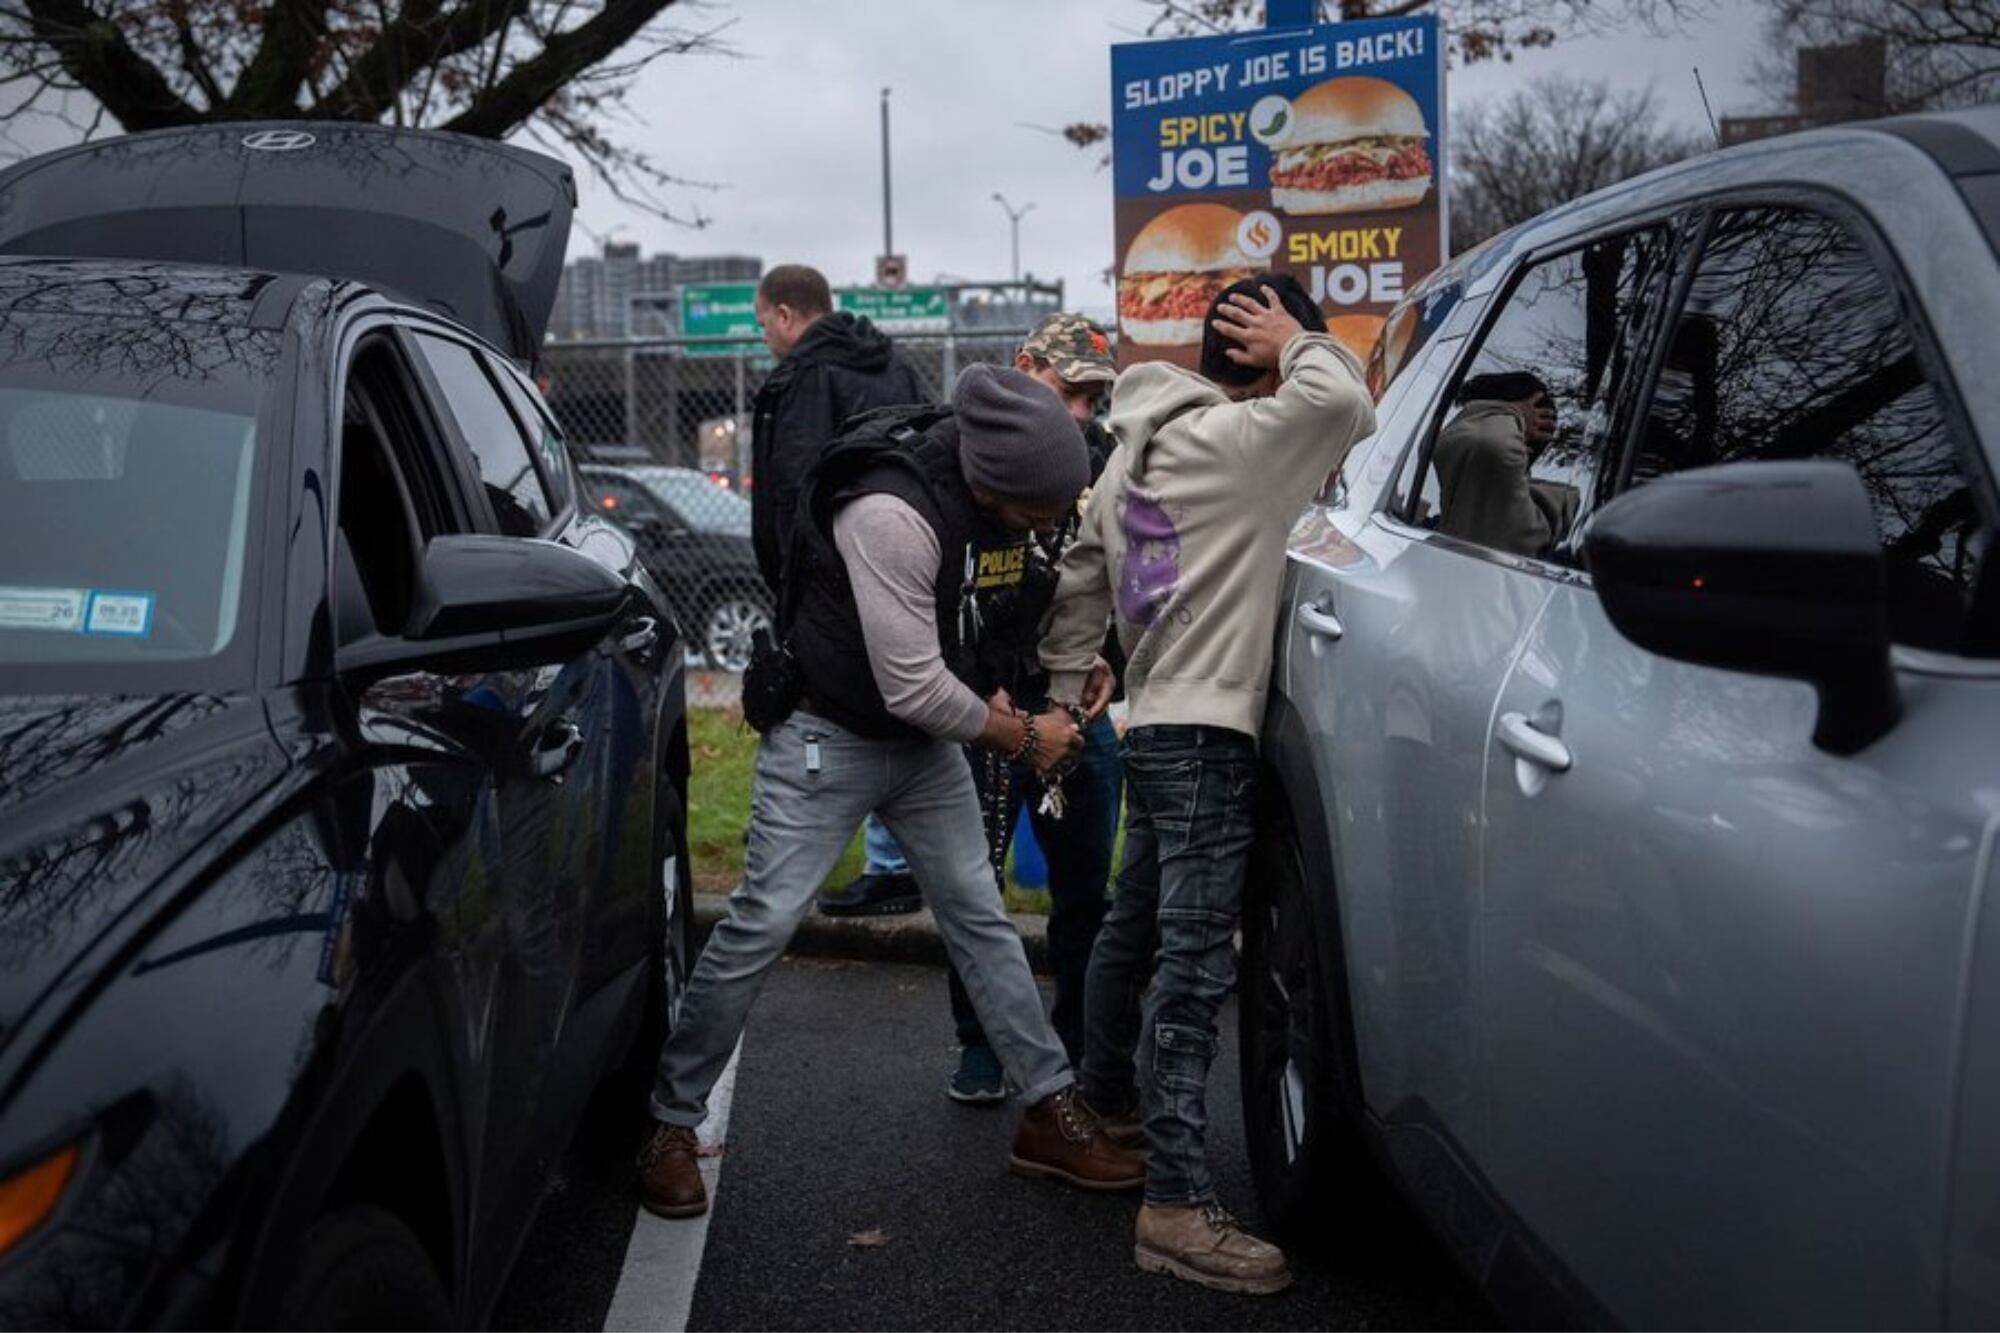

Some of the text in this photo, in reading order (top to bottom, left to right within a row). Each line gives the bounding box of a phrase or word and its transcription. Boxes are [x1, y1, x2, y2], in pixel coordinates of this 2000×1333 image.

[1125, 27, 1424, 109] SLOPPY JOE IS BACK!
[1160, 112, 1246, 148] SPICY
[1147, 145, 1249, 191] JOE
[1289, 227, 1402, 263] SMOKY
[1308, 262, 1404, 305] JOE
[978, 546, 1025, 576] POLICE
